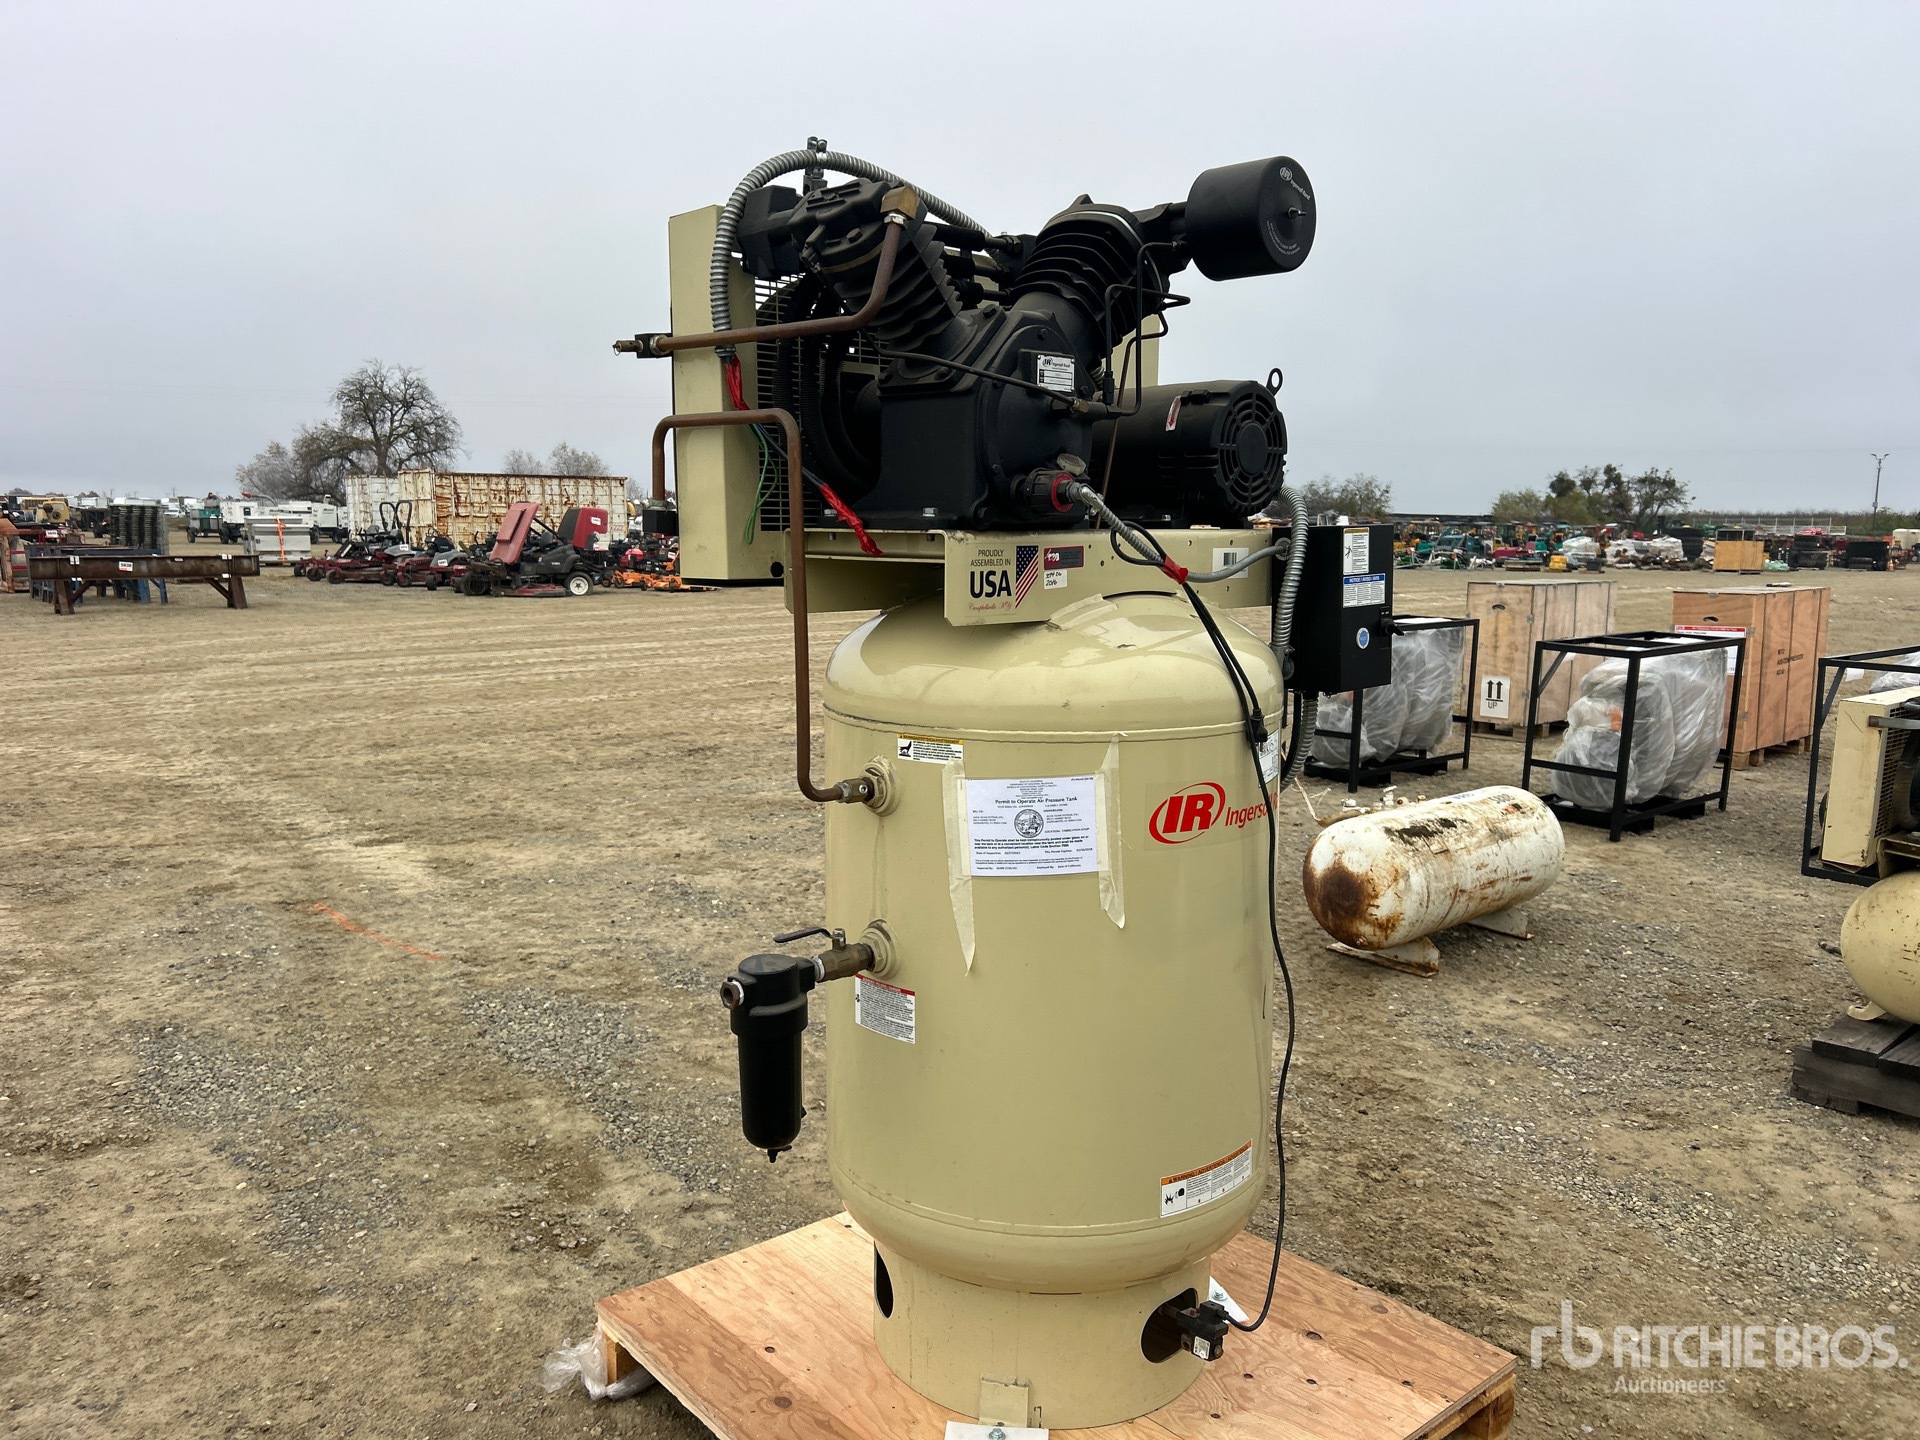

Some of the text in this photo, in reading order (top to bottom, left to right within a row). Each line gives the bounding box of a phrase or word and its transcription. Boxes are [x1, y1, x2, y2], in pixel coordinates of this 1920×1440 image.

[978, 549, 1004, 557] PROUDLY
[970, 558, 1011, 567] ASSEMBLED IN
[970, 570, 1012, 599] USA
[1487, 701, 1498, 709] UP
[1162, 793, 1215, 834] IR
